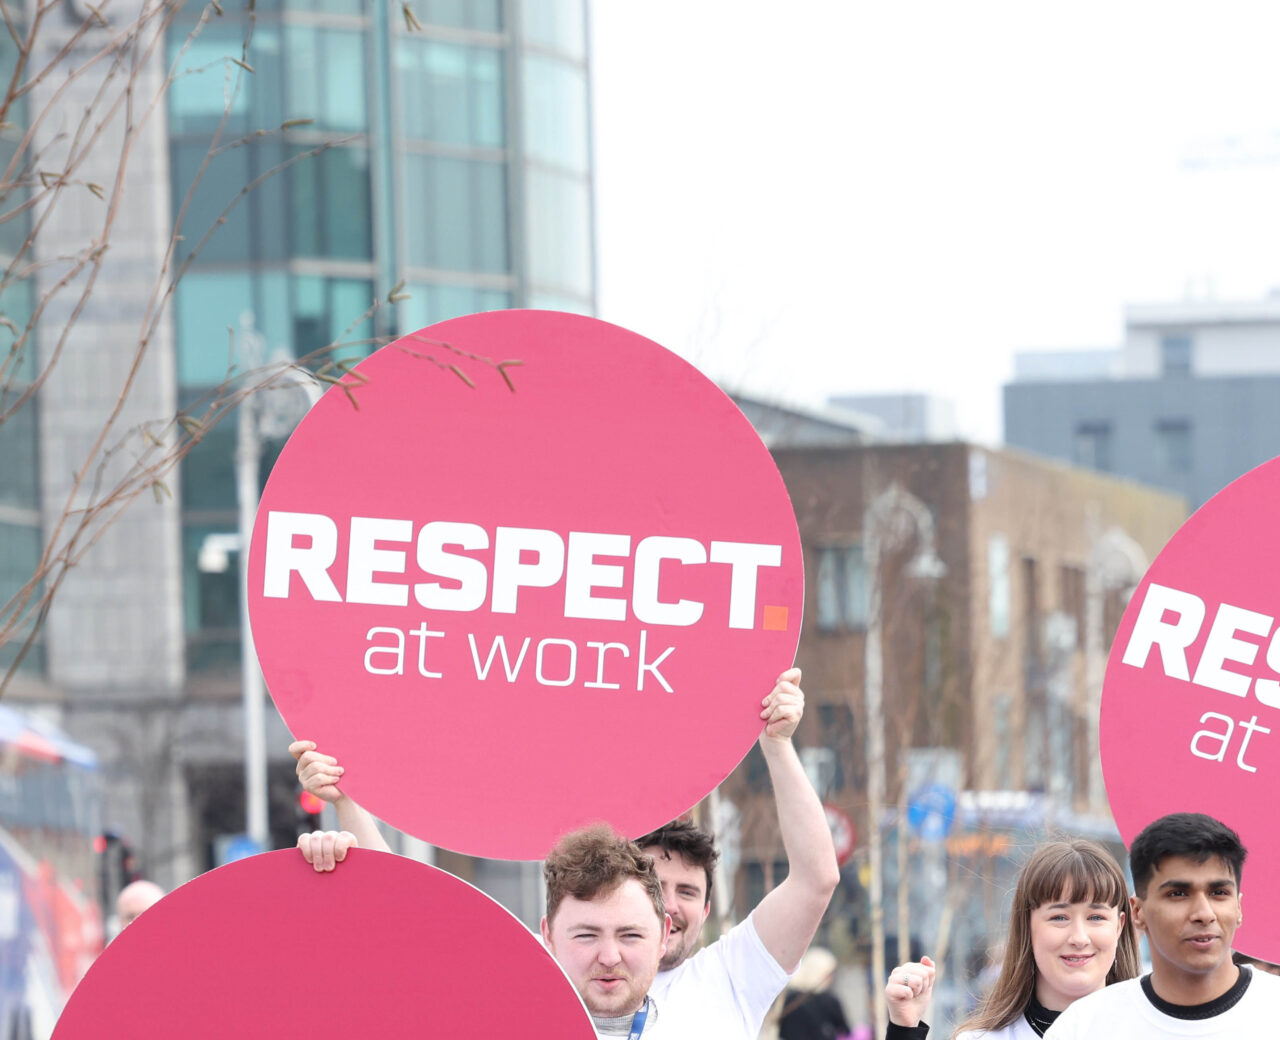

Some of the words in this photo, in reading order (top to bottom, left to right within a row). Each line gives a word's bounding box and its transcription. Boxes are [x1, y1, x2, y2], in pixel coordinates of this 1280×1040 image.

[263, 510, 788, 630] RESPECT.
[364, 621, 445, 679] at
[467, 630, 676, 693] work
[1190, 711, 1271, 773] at
